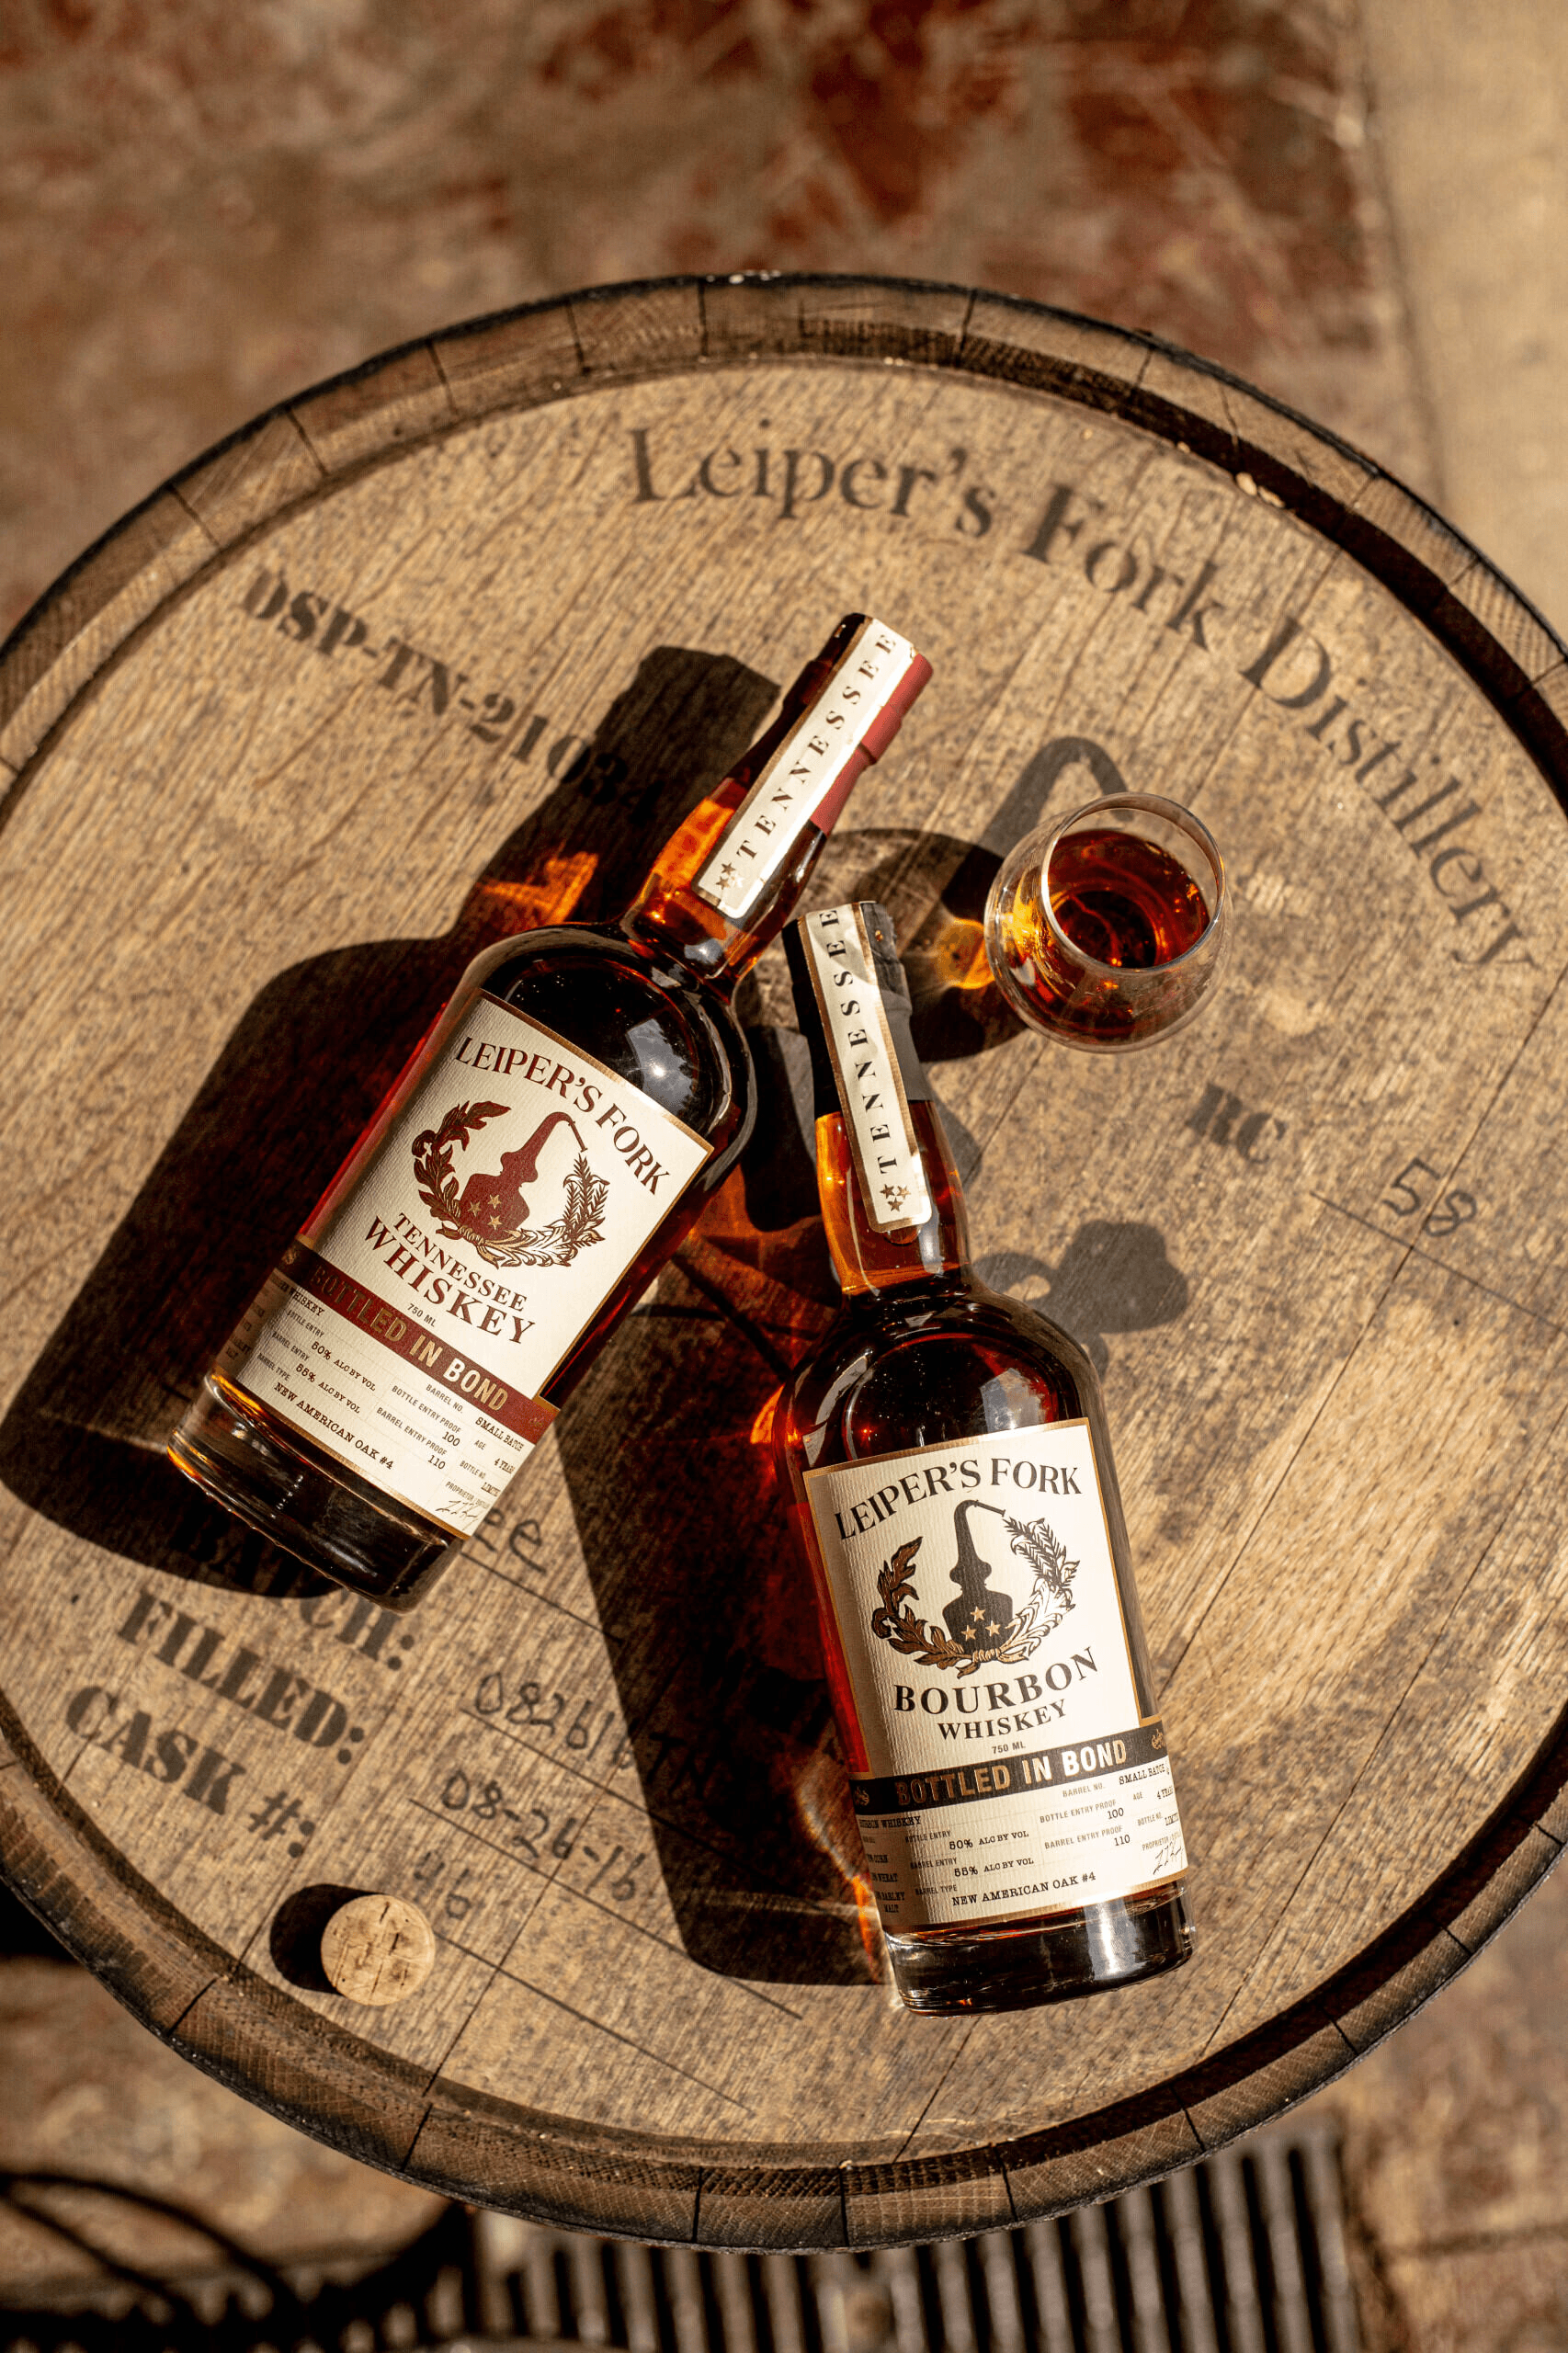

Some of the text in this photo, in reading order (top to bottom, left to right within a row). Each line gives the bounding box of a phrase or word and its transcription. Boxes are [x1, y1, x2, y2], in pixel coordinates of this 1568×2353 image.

[629, 418, 1540, 970] Leiper's Fork Distillery
[736, 634, 896, 860] TENNESSEE
[820, 909, 898, 1174] TENNESSEE
[455, 1036, 671, 1196] LEIPER'S FORK
[365, 1215, 536, 1345] WHISKEY
[392, 1211, 528, 1313] TENNESSEE
[305, 1322, 325, 1337] ENTRY
[407, 1302, 437, 1327] 750 ML
[271, 1331, 290, 1349] BARREL
[290, 1345, 311, 1361] ENTRY
[311, 1265, 407, 1342] BOTTLED
[409, 1334, 443, 1369] IN
[442, 1358, 509, 1412] BOND
[276, 1367, 291, 1381] TYPE
[311, 1340, 377, 1392] 50% ALC BY VOL
[318, 1381, 335, 1394] ALC
[333, 1391, 347, 1402] BY
[346, 1399, 361, 1415] VOL
[391, 1384, 462, 1448] BOTTLE ENTRY PROOF 100
[426, 1383, 451, 1406] BARREL
[452, 1402, 464, 1414] NO.
[474, 1416, 505, 1440] SMALL
[274, 1381, 395, 1471] NEW AMERICAN OAK #4
[376, 1406, 448, 1470] BARREL ENTRY PROOF 110
[473, 1439, 487, 1450] AGE
[460, 1460, 480, 1476] BOTTLE
[835, 1457, 1083, 1540] LEIPER'S FORK
[118, 1588, 365, 1765] FILLED:
[893, 1646, 1099, 1715] BOURBON
[937, 1699, 1066, 1741] WHISKEY
[64, 1686, 248, 1816] CASK
[992, 1741, 1027, 1755] 750 ML
[894, 1739, 1127, 1807] BOTTLED IN BOND
[1062, 1785, 1092, 1798] BARREL
[1118, 1769, 1148, 1786] SMALL
[1040, 1799, 1125, 1824] BOTTLE ENTRY PROOF 100
[1137, 1814, 1156, 1827] BOTTLE
[928, 1830, 952, 1841] ENTRY
[949, 1830, 1029, 1851] 50% ALC BY VOL
[1044, 1824, 1131, 1850] BARREL ENTRY PROOF 110
[935, 1857, 958, 1868] ENTRY
[953, 1857, 1035, 1878] 55% ALC BY VOL
[939, 1883, 959, 1894] TYPE
[951, 1871, 1096, 1907] NEW AMERICAN OAK #4
